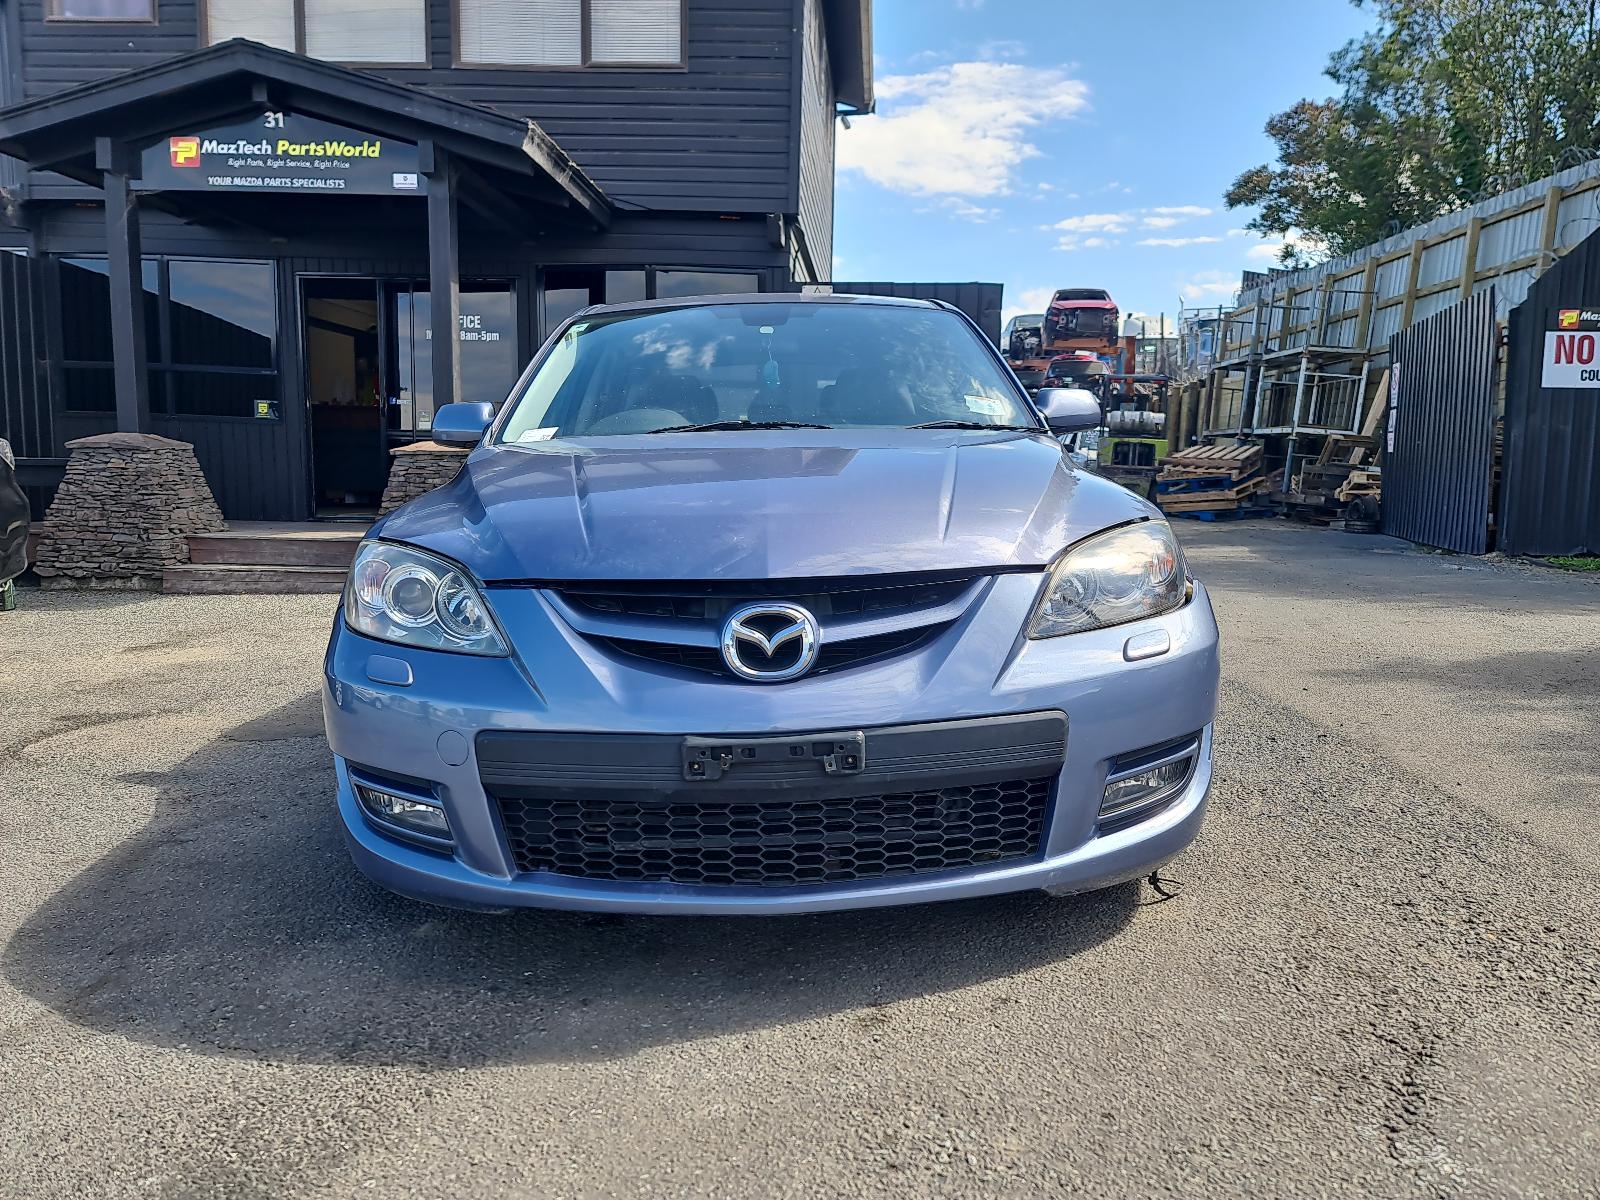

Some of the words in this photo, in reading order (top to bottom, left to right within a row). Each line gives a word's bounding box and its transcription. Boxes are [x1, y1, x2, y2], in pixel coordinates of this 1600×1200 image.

[263, 111, 284, 128] 31
[201, 139, 272, 154] MazTech
[276, 140, 381, 157] PartsWorld
[227, 158, 245, 168] Right
[246, 158, 265, 167] Parts,
[266, 158, 285, 168] Right
[313, 159, 332, 169] Right
[332, 160, 350, 169] Price
[207, 176, 232, 186] YOUR
[233, 177, 263, 186] MAZDA
[263, 177, 291, 187] PARTS
[292, 178, 346, 189] SPECIALISTS
[460, 330, 500, 342] 8am-5pm
[1553, 335, 1595, 365] NO
